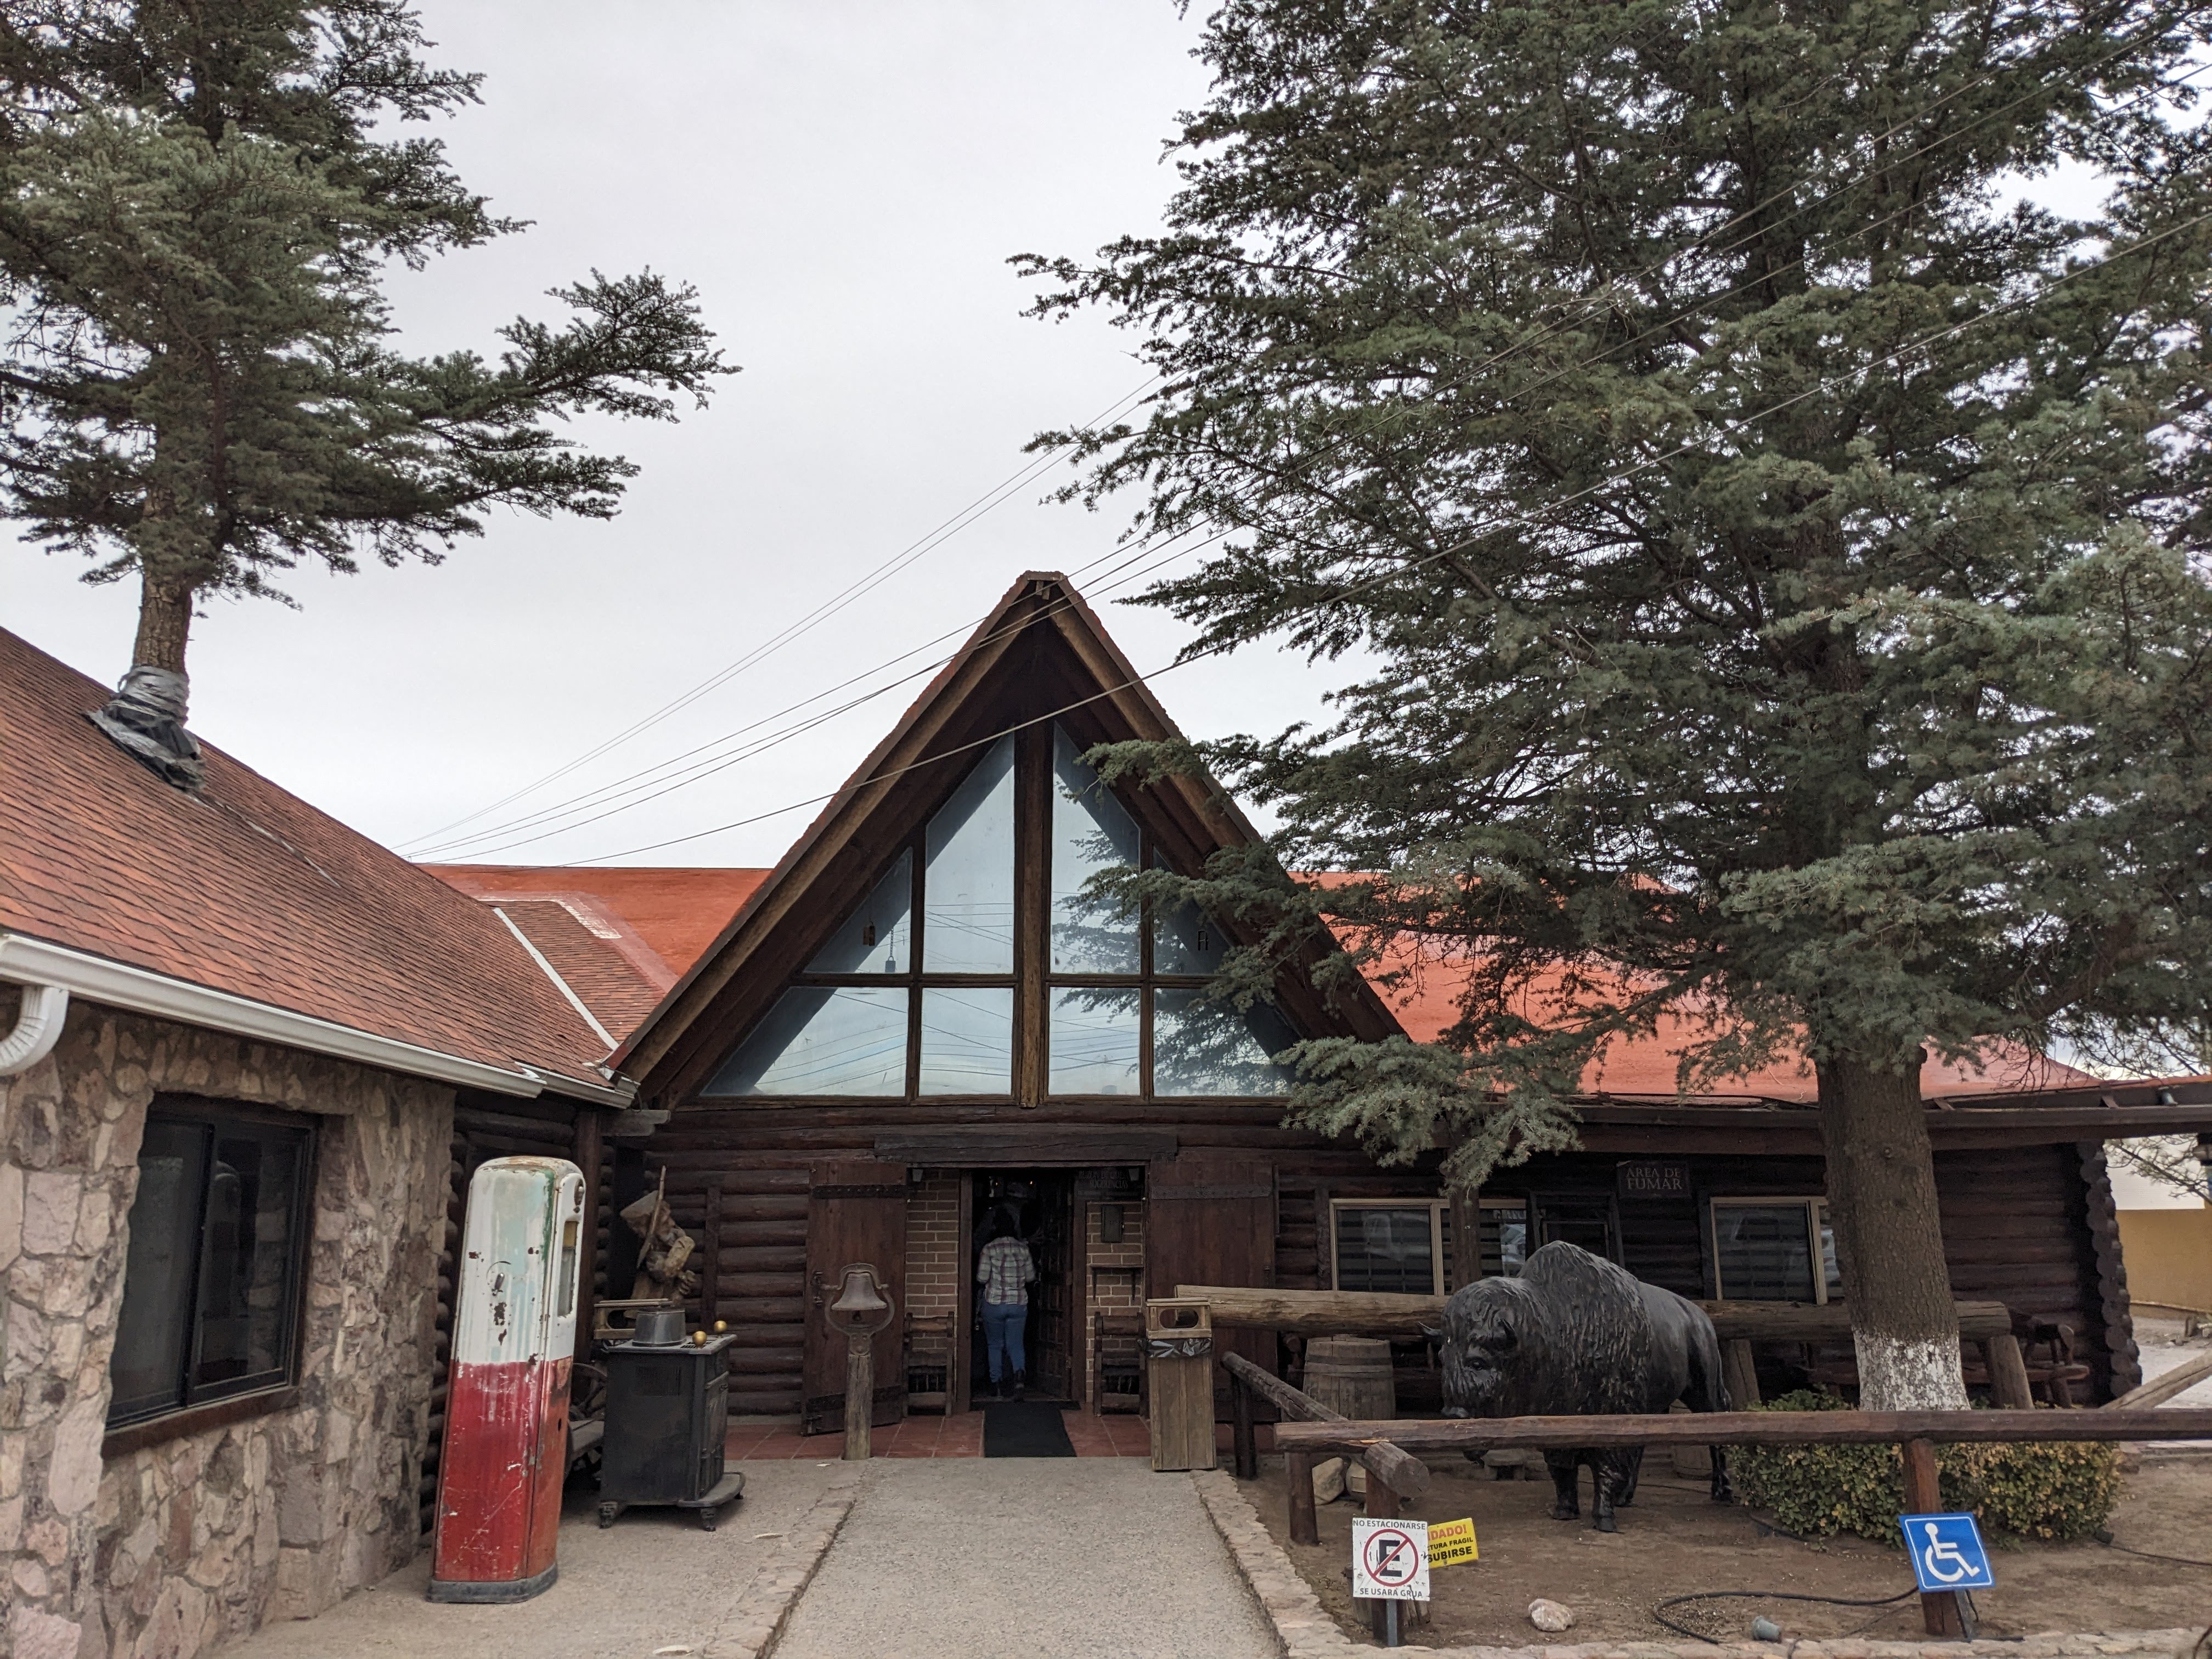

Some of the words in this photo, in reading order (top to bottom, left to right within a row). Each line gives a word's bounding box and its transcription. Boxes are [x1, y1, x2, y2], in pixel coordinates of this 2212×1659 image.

[1626, 1167, 1660, 1178] AREA
[1664, 1167, 1681, 1178] DE
[1627, 1178, 1683, 1190] FUMAR
[1367, 1521, 1426, 1530] ESTACIONARSE
[1449, 1537, 1473, 1546] FRAGIL
[1428, 1546, 1472, 1563] SUBIRSE
[1372, 1588, 1398, 1596] USARA
[1400, 1589, 1423, 1598] GRUA
